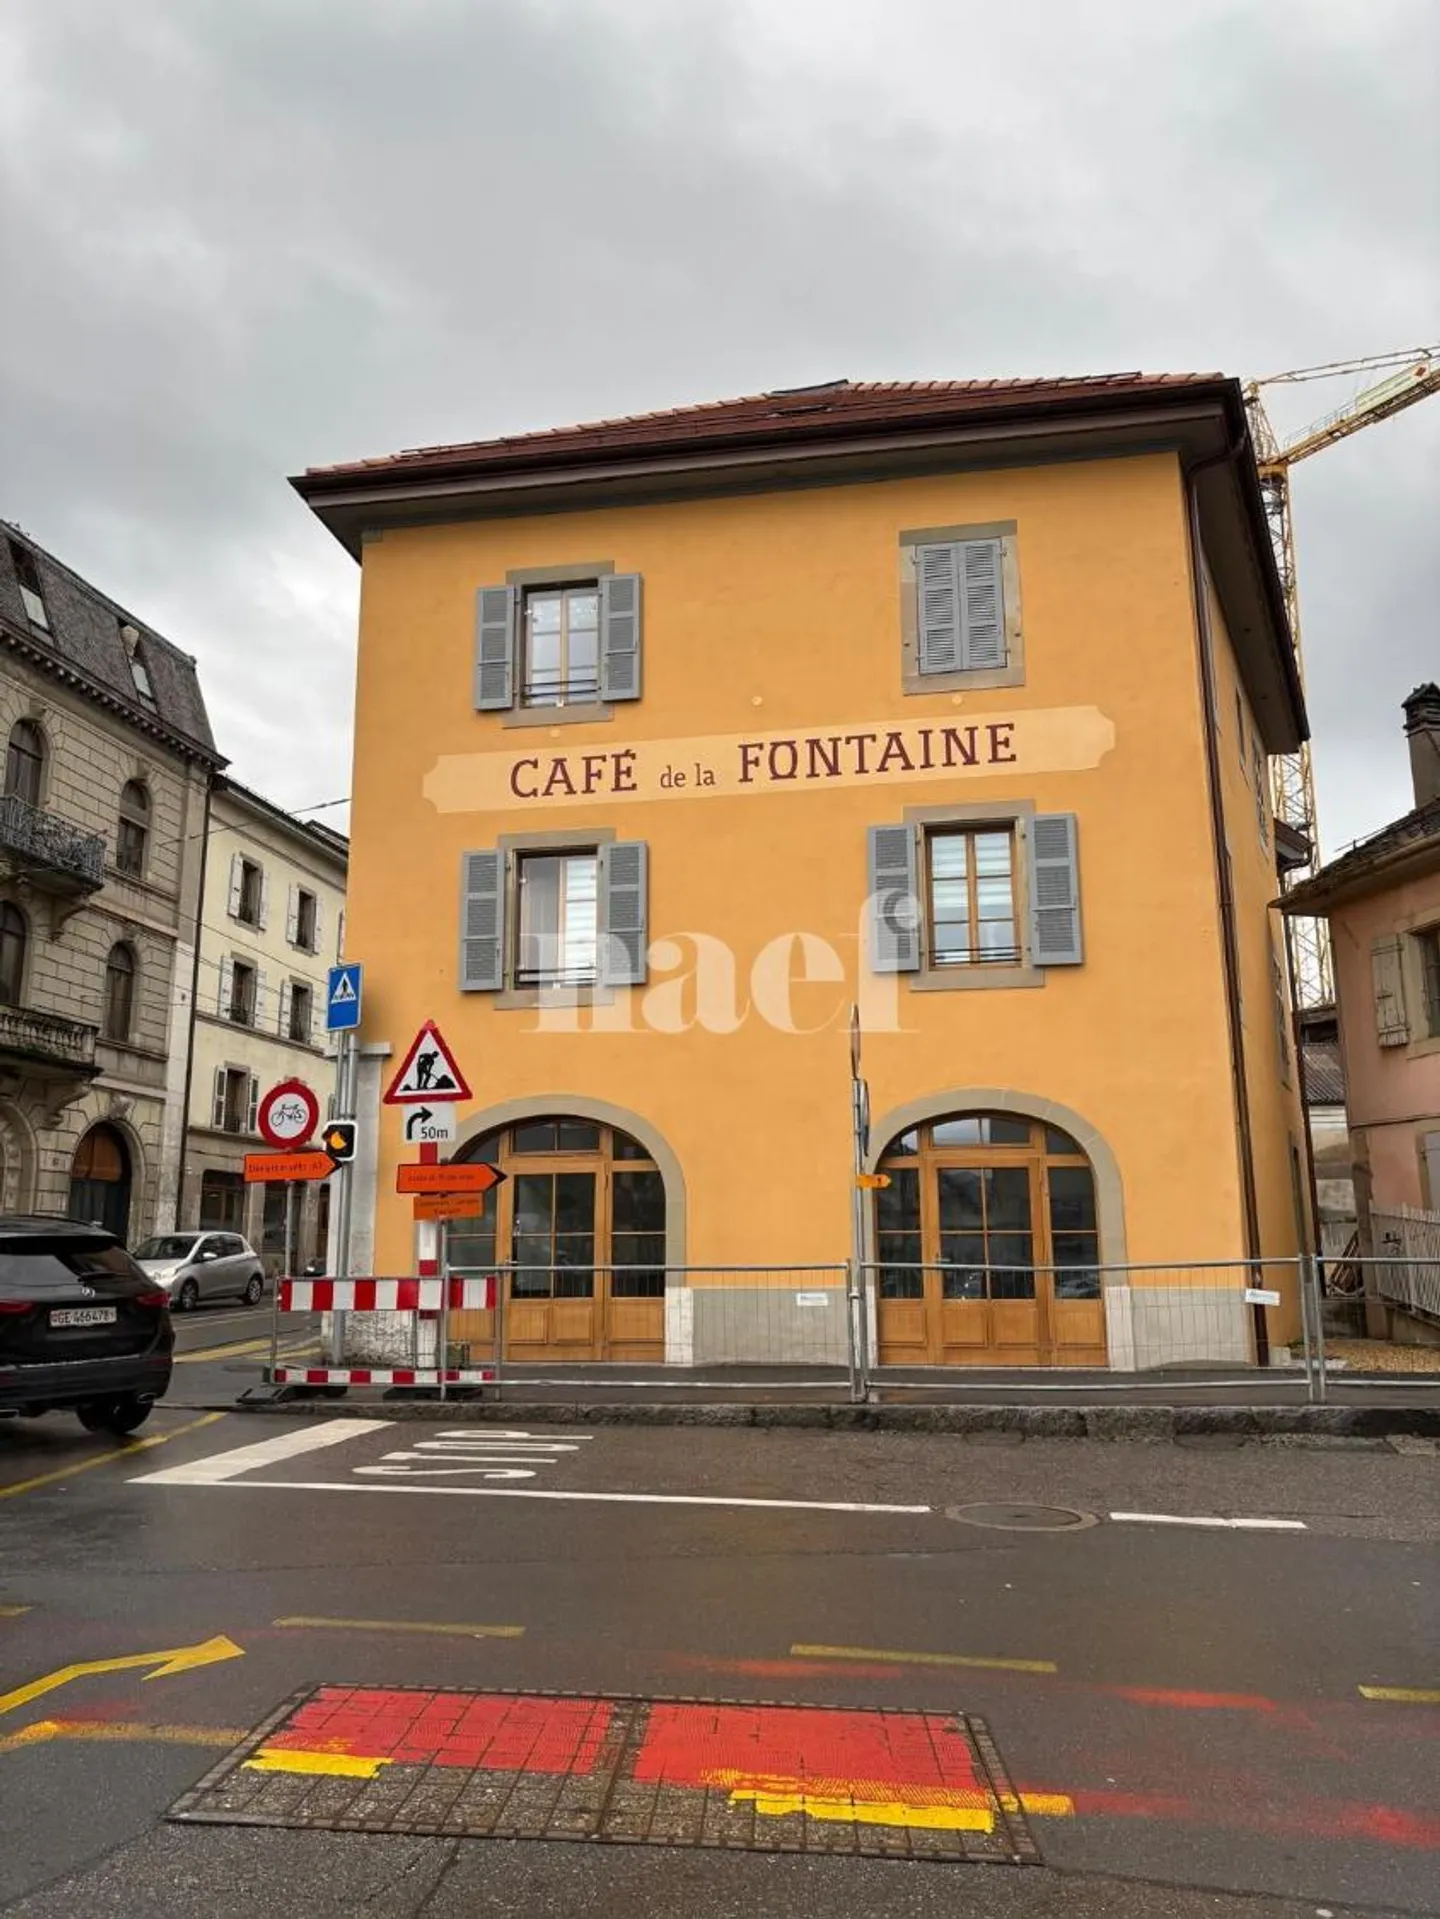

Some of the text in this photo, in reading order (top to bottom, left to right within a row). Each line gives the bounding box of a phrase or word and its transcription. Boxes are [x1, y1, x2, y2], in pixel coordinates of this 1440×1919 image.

[510, 722, 1017, 798] CAFÉ de la FONTAINE
[421, 1126, 449, 1140] 50m
[352, 1429, 594, 1479] STOP
